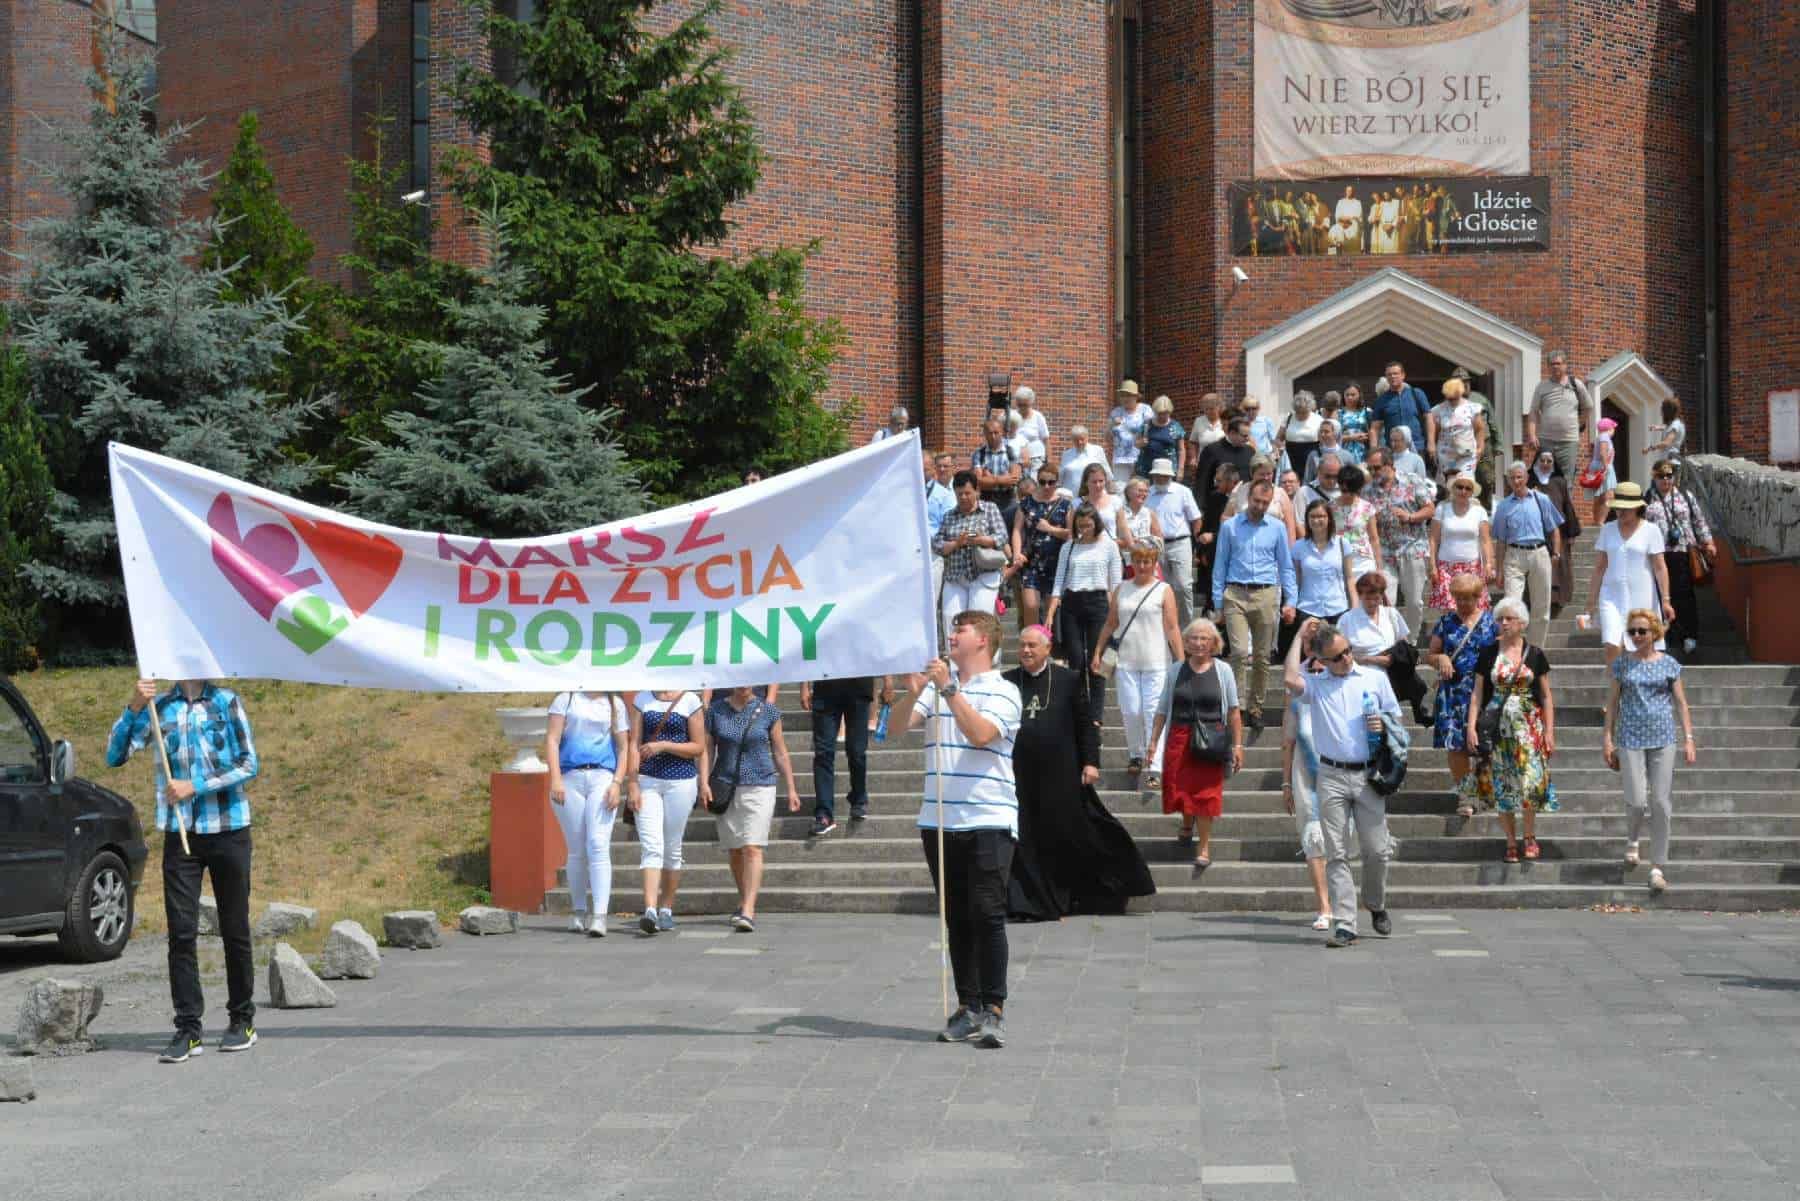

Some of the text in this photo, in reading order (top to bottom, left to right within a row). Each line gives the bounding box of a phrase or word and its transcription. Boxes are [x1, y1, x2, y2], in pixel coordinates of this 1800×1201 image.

[1283, 72, 1501, 108] NIE BÓJ SIĘ,
[1293, 111, 1479, 135] WIERZ TYLKO!
[1473, 189, 1532, 209] Idźcie
[437, 506, 726, 568] MARSZ
[458, 543, 804, 605] DLA ŻYCIA
[422, 603, 837, 667] I RODZINY
